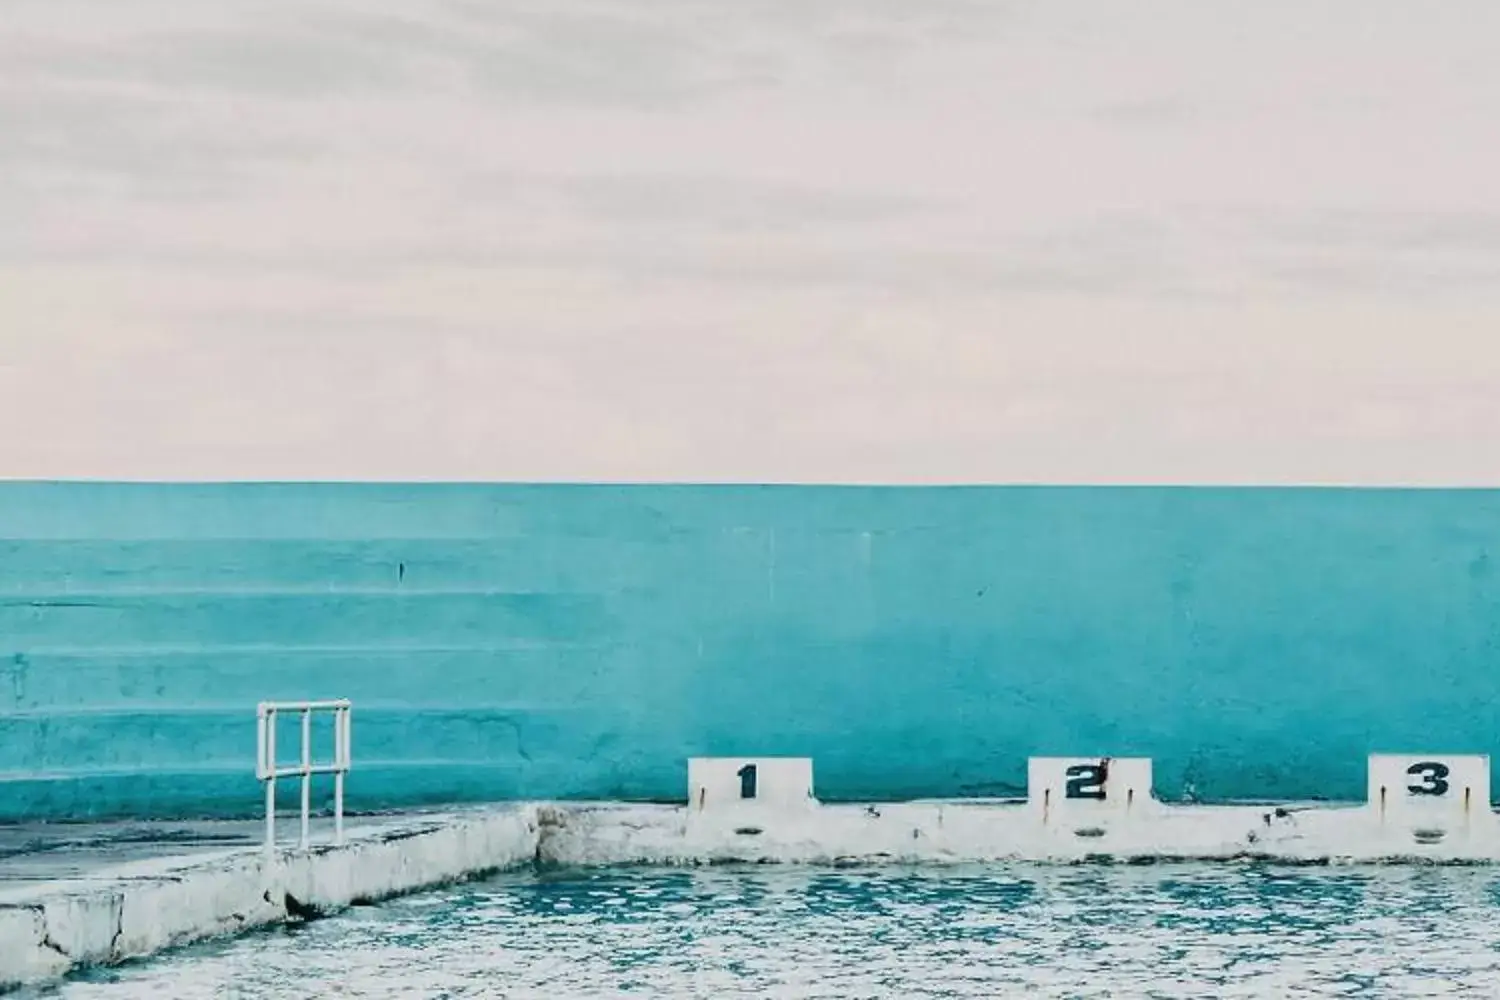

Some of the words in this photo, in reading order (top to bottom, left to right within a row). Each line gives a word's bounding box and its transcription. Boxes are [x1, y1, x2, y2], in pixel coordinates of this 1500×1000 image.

[737, 764, 757, 799] 1
[1065, 765, 1107, 800] 2
[1407, 762, 1449, 797] 3
